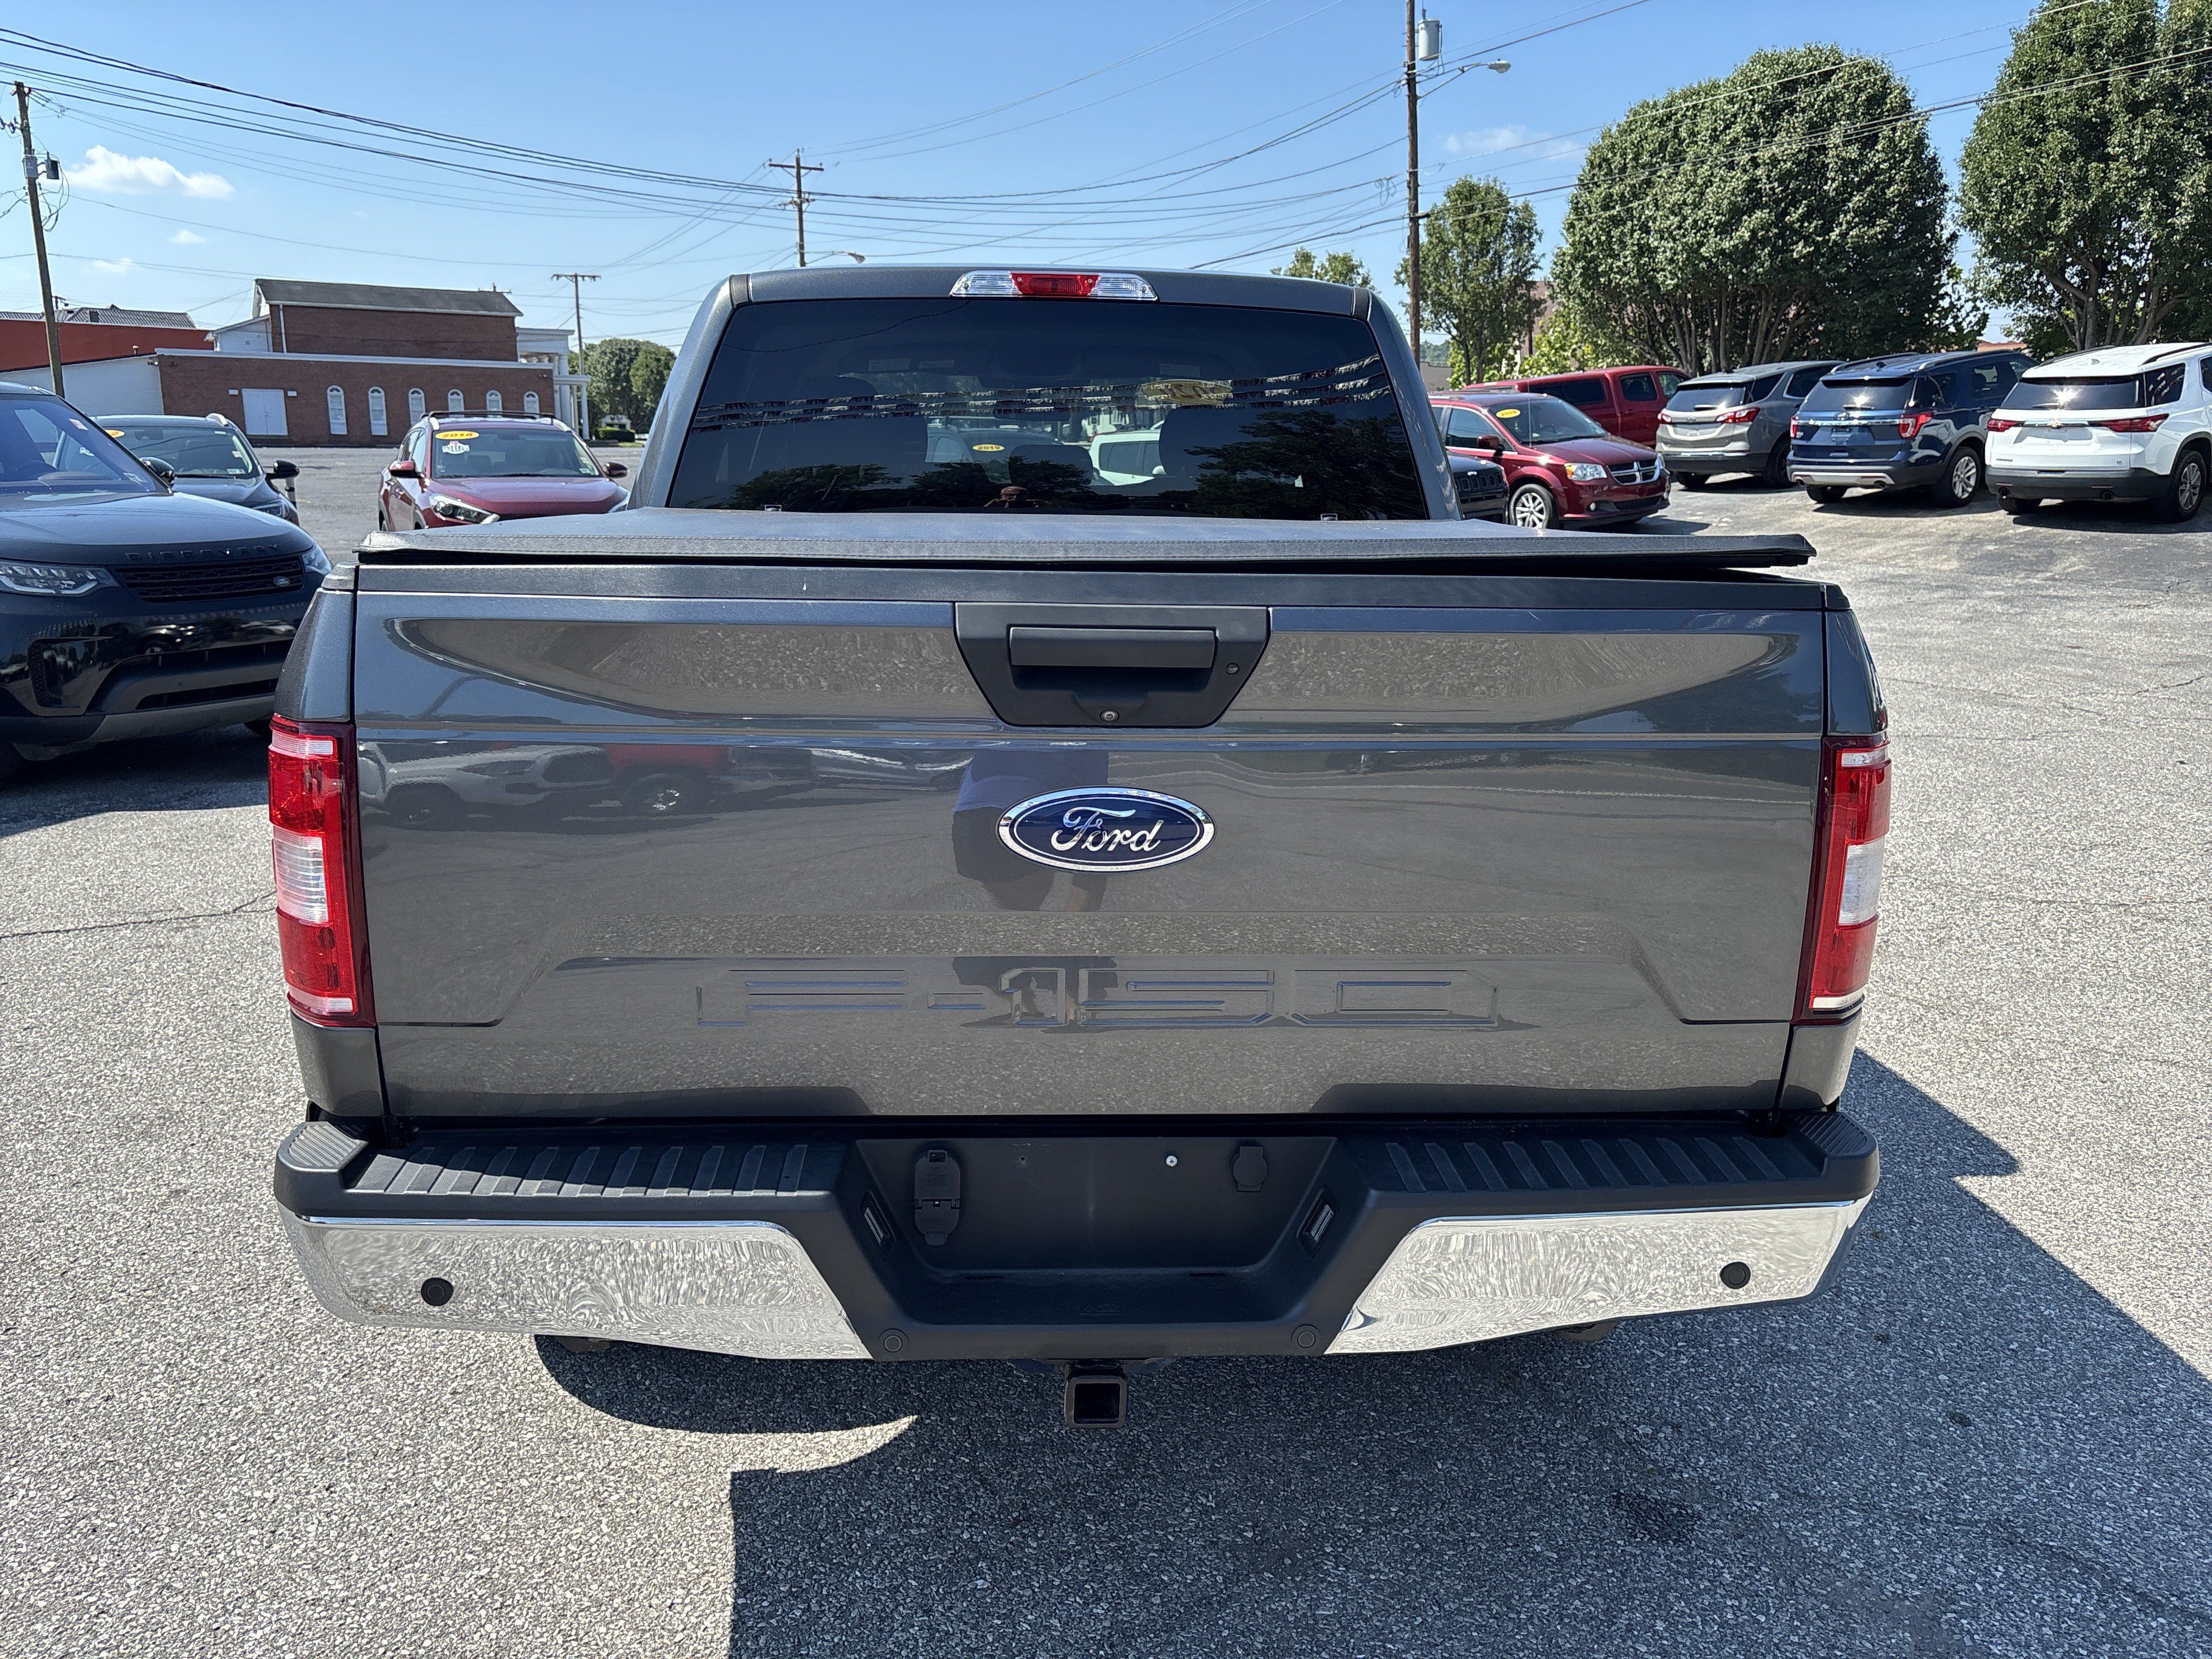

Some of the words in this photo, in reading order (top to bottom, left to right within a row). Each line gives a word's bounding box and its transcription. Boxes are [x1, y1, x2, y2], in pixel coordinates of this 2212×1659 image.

[125, 544, 279, 562] DISCOVERY
[1050, 806, 1164, 852] Ford
[696, 968, 1500, 1028] F-150
